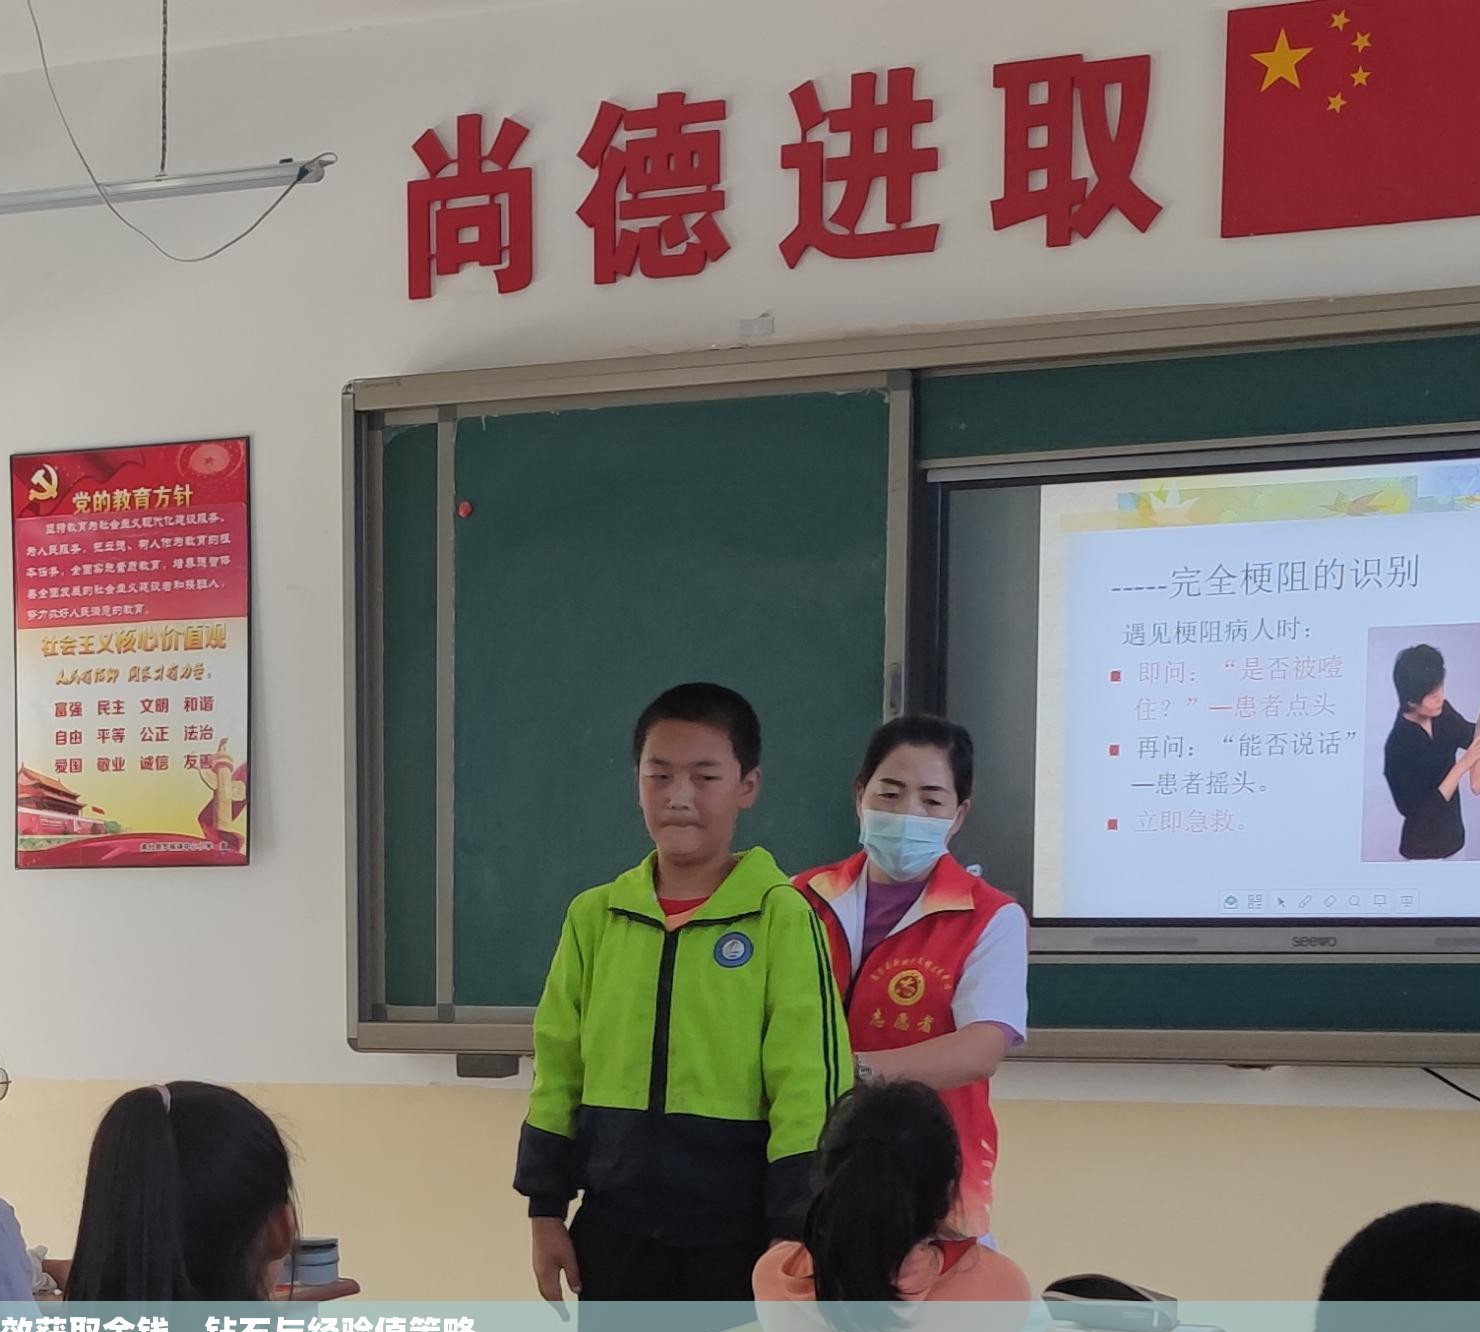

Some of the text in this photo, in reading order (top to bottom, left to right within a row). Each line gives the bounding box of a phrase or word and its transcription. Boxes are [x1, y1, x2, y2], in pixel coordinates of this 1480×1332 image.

[406, 53, 1163, 300] 尚德进取
[72, 484, 194, 514] 党的教育方针
[41, 624, 226, 657] 社会主义核心价值观
[1121, 616, 1313, 647] 遇见梗阻病人时：
[55, 695, 214, 717] 富强 民主 文明 和谐
[55, 725, 214, 746] 自由 平等 公正 法治
[54, 754, 214, 773] 爱国 敬业 诚信 友善
[1135, 810, 1247, 835] 立即急救。
[870, 1008, 936, 1034] 志愿者
